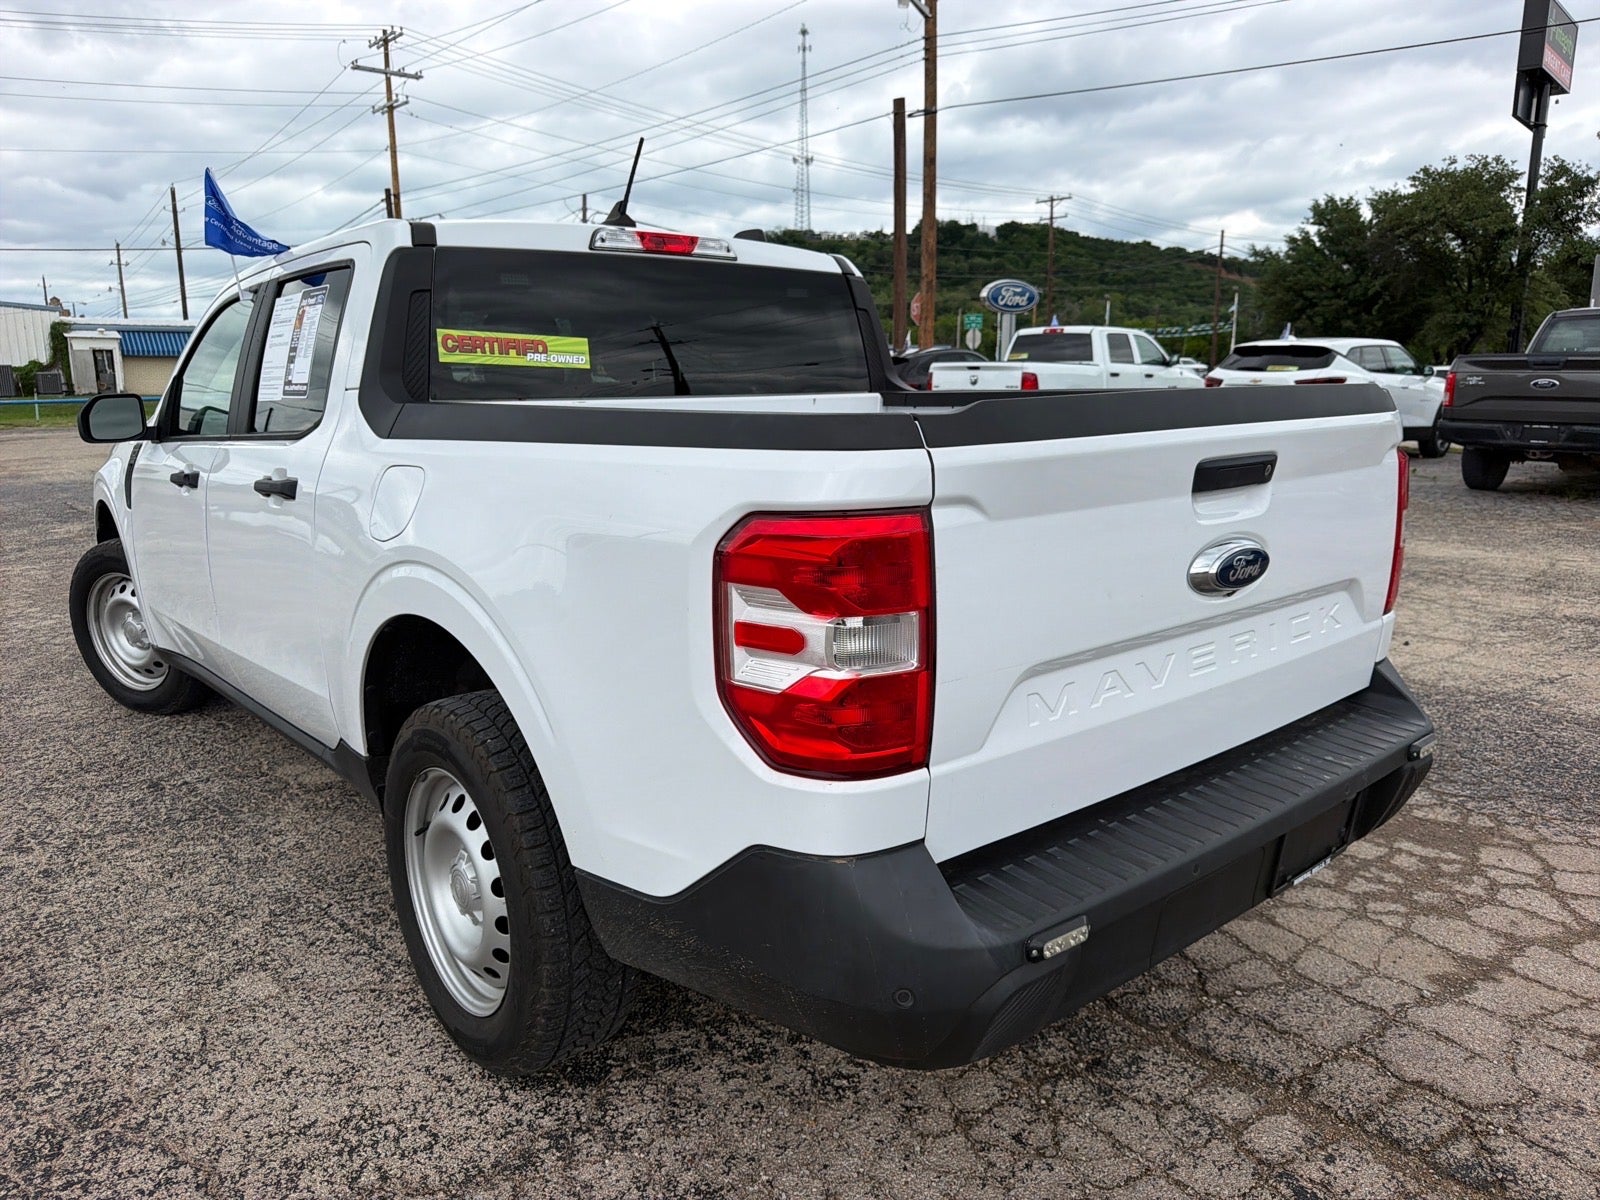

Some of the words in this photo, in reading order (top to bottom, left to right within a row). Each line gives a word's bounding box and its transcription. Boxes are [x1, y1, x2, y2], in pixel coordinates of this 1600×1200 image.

[230, 224, 279, 250] Advantage
[998, 286, 1031, 306] Ford
[441, 333, 549, 356] CERTIFIED
[526, 353, 586, 365] PRE-OWNED
[1229, 554, 1262, 582] Ford
[1026, 602, 1343, 728] MAVERICK
